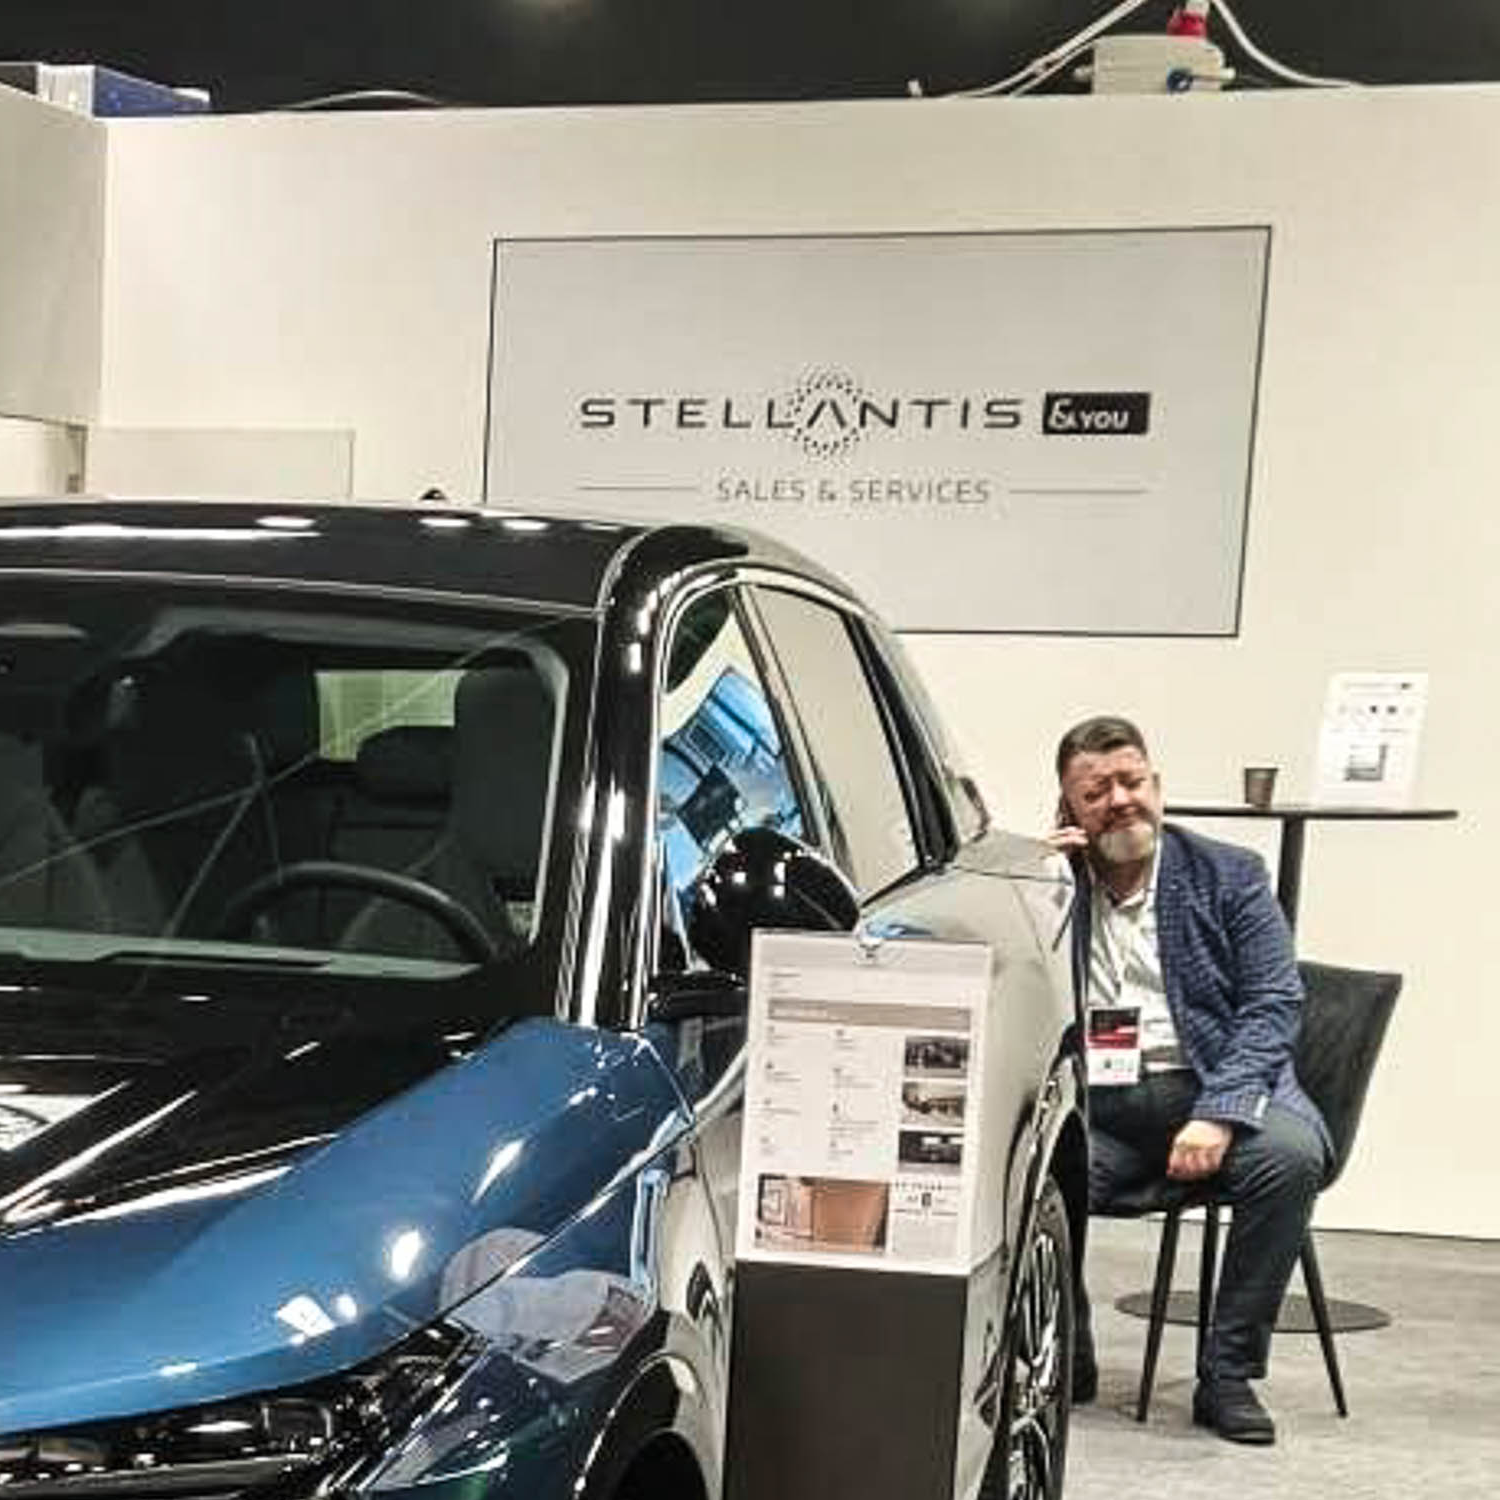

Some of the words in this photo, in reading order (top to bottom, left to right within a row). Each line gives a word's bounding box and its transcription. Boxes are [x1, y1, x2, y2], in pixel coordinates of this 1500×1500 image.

[580, 398, 1024, 429] STELLANTIS
[716, 479, 805, 501] SALES
[818, 480, 837, 501] &
[850, 480, 989, 503] SERVICES
